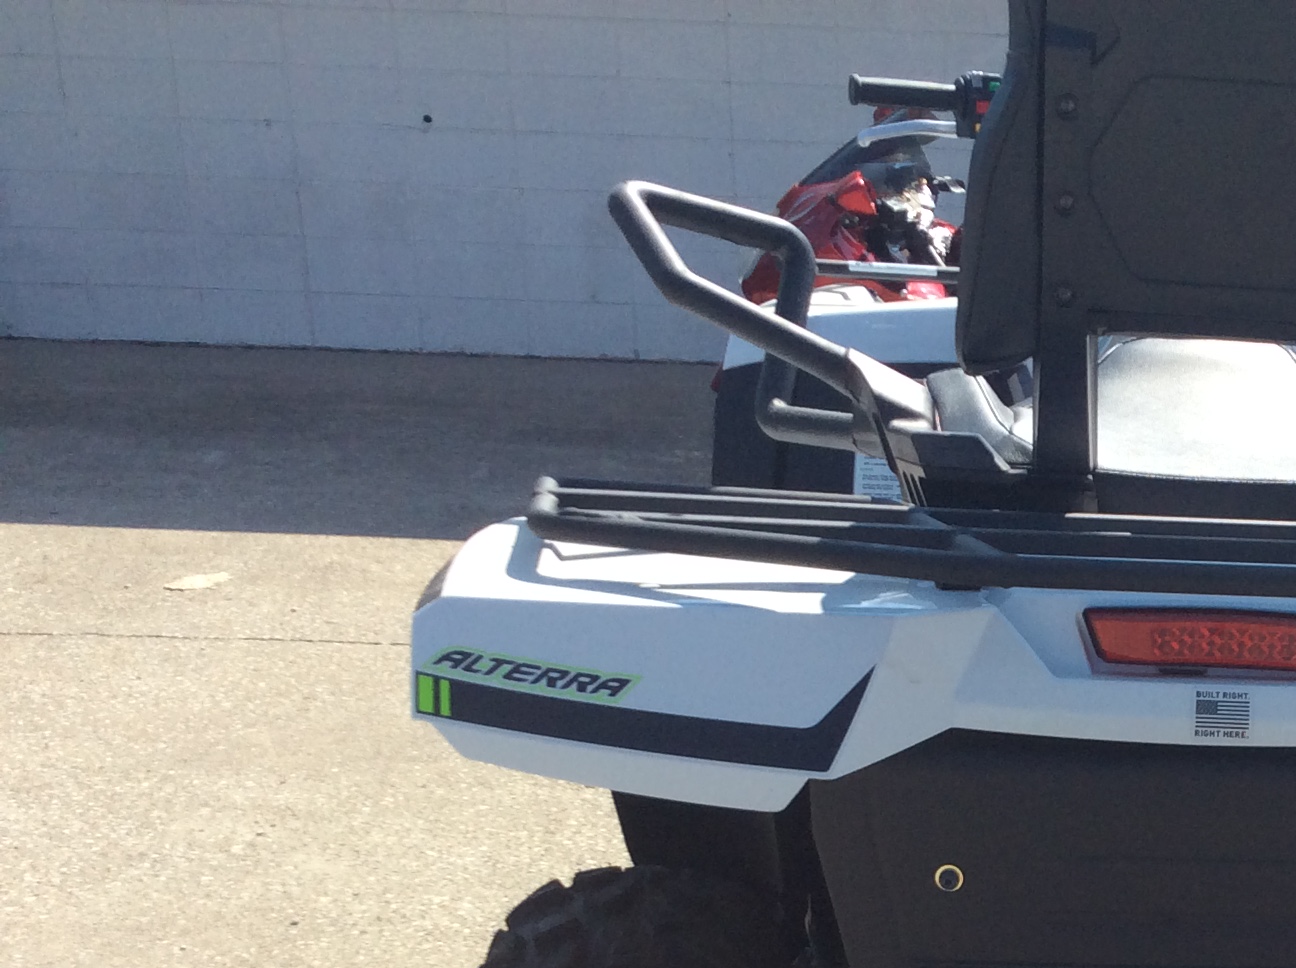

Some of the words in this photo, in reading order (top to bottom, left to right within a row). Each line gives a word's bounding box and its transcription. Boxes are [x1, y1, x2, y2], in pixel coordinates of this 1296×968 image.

[432, 650, 632, 697] ALTERRA
[1196, 690, 1220, 698] BUILT
[1194, 729, 1221, 738] RIGHT
